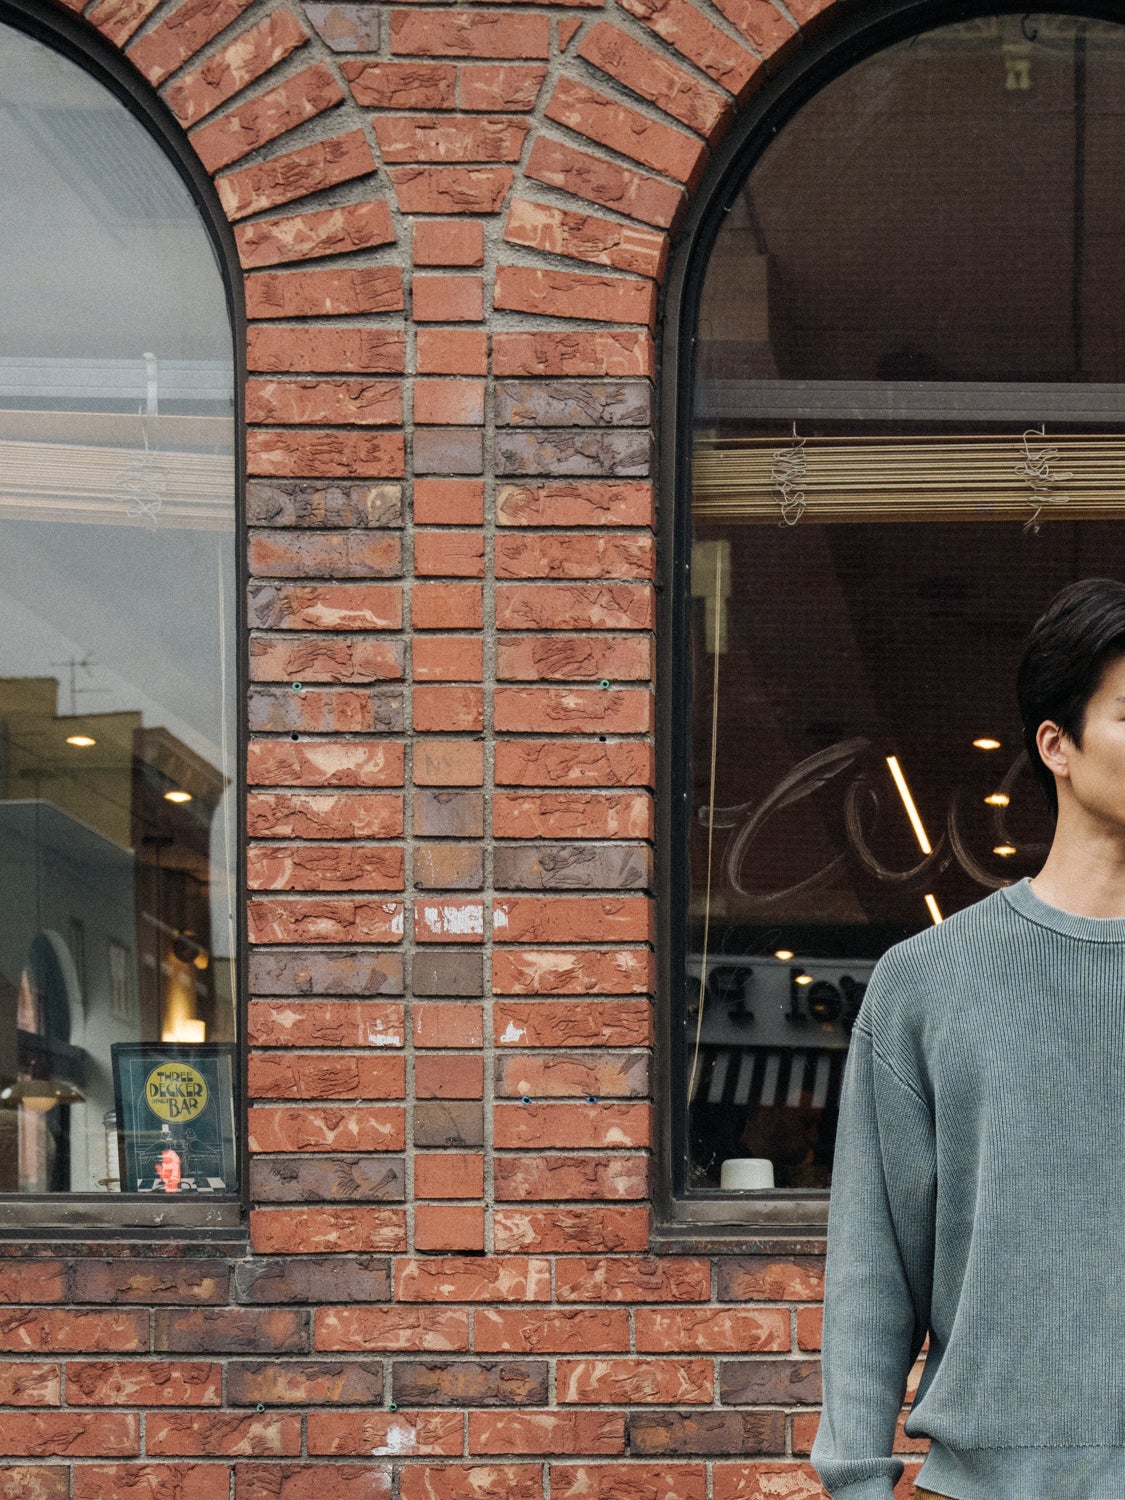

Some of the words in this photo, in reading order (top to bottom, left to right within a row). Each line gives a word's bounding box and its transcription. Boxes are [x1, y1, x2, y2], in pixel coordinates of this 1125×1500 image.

[157, 1071, 194, 1082] THREE
[150, 1082, 203, 1098] DECKER
[169, 1098, 198, 1118] BAR
